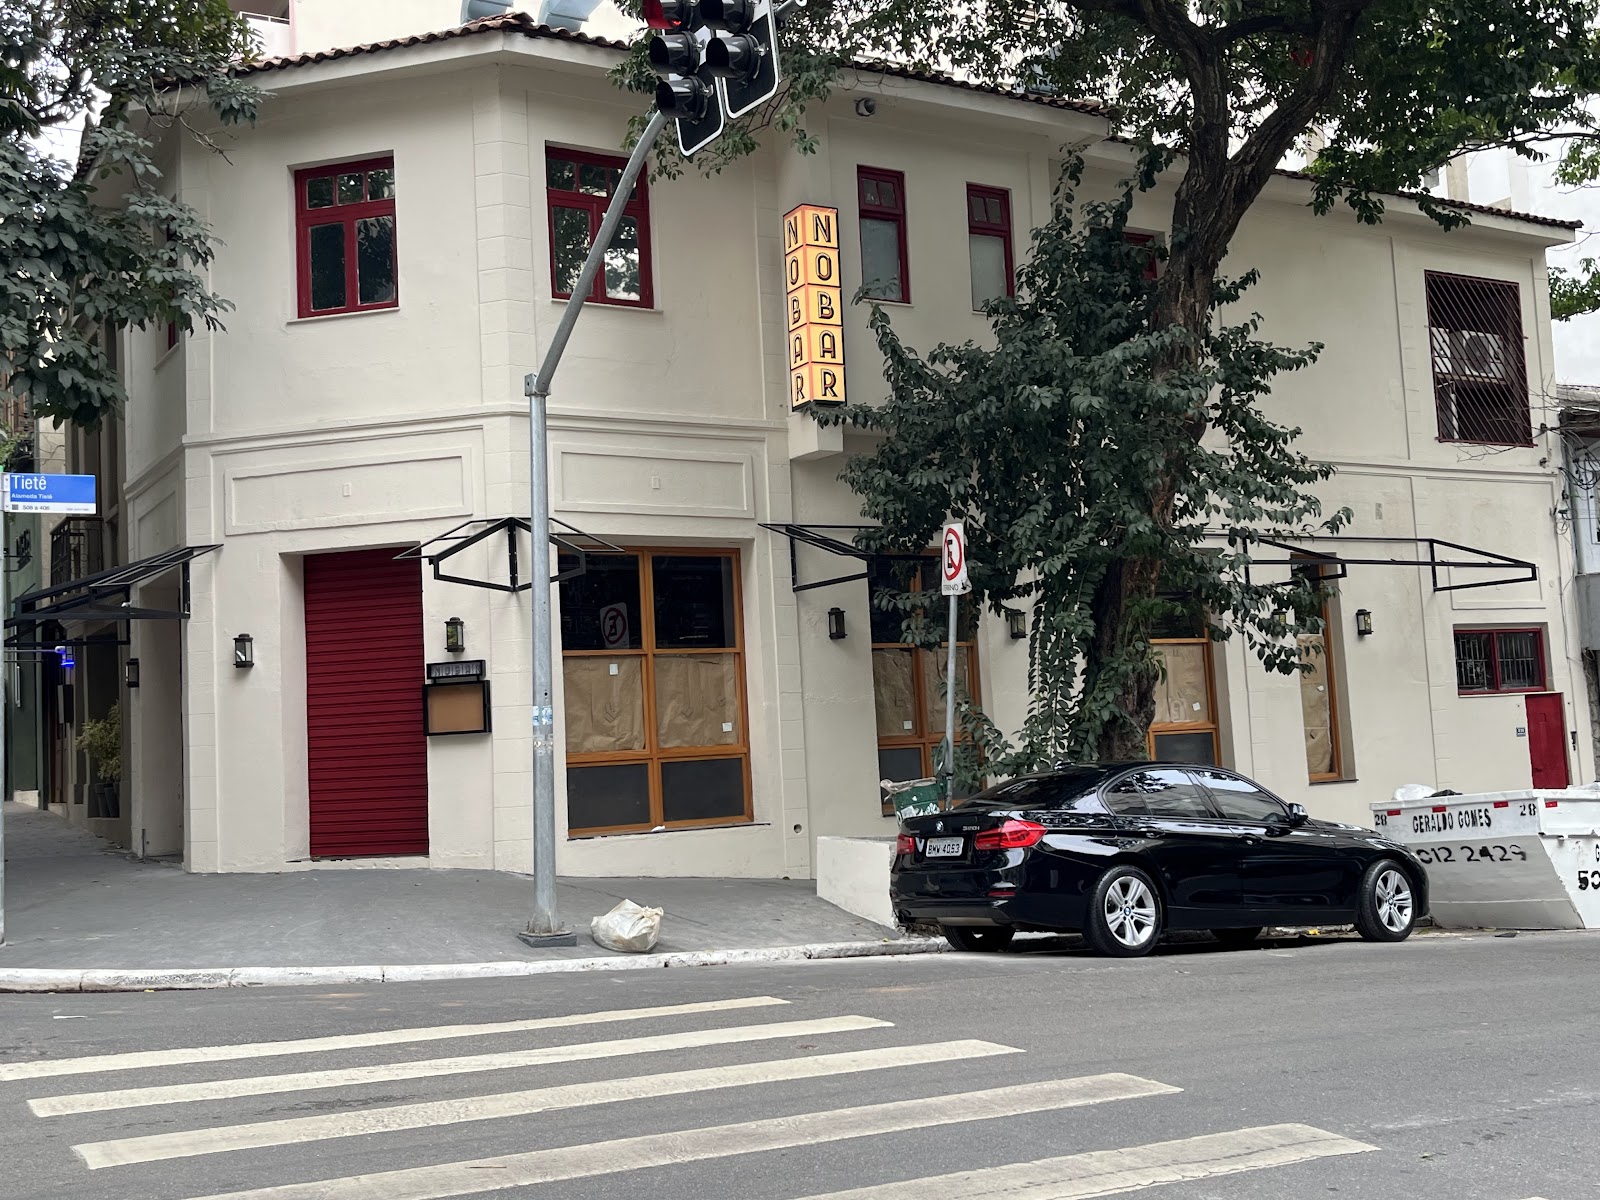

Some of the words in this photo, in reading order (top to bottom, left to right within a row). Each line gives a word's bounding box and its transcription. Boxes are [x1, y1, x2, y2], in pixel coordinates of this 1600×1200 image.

[787, 216, 804, 401] NOBAR
[813, 214, 838, 398] NOBAR
[11, 475, 47, 490] Tietê
[1520, 803, 1536, 816] 28
[1375, 814, 1387, 826] 28
[1413, 812, 1454, 833] GERALDO
[1458, 808, 1492, 828] GOMES
